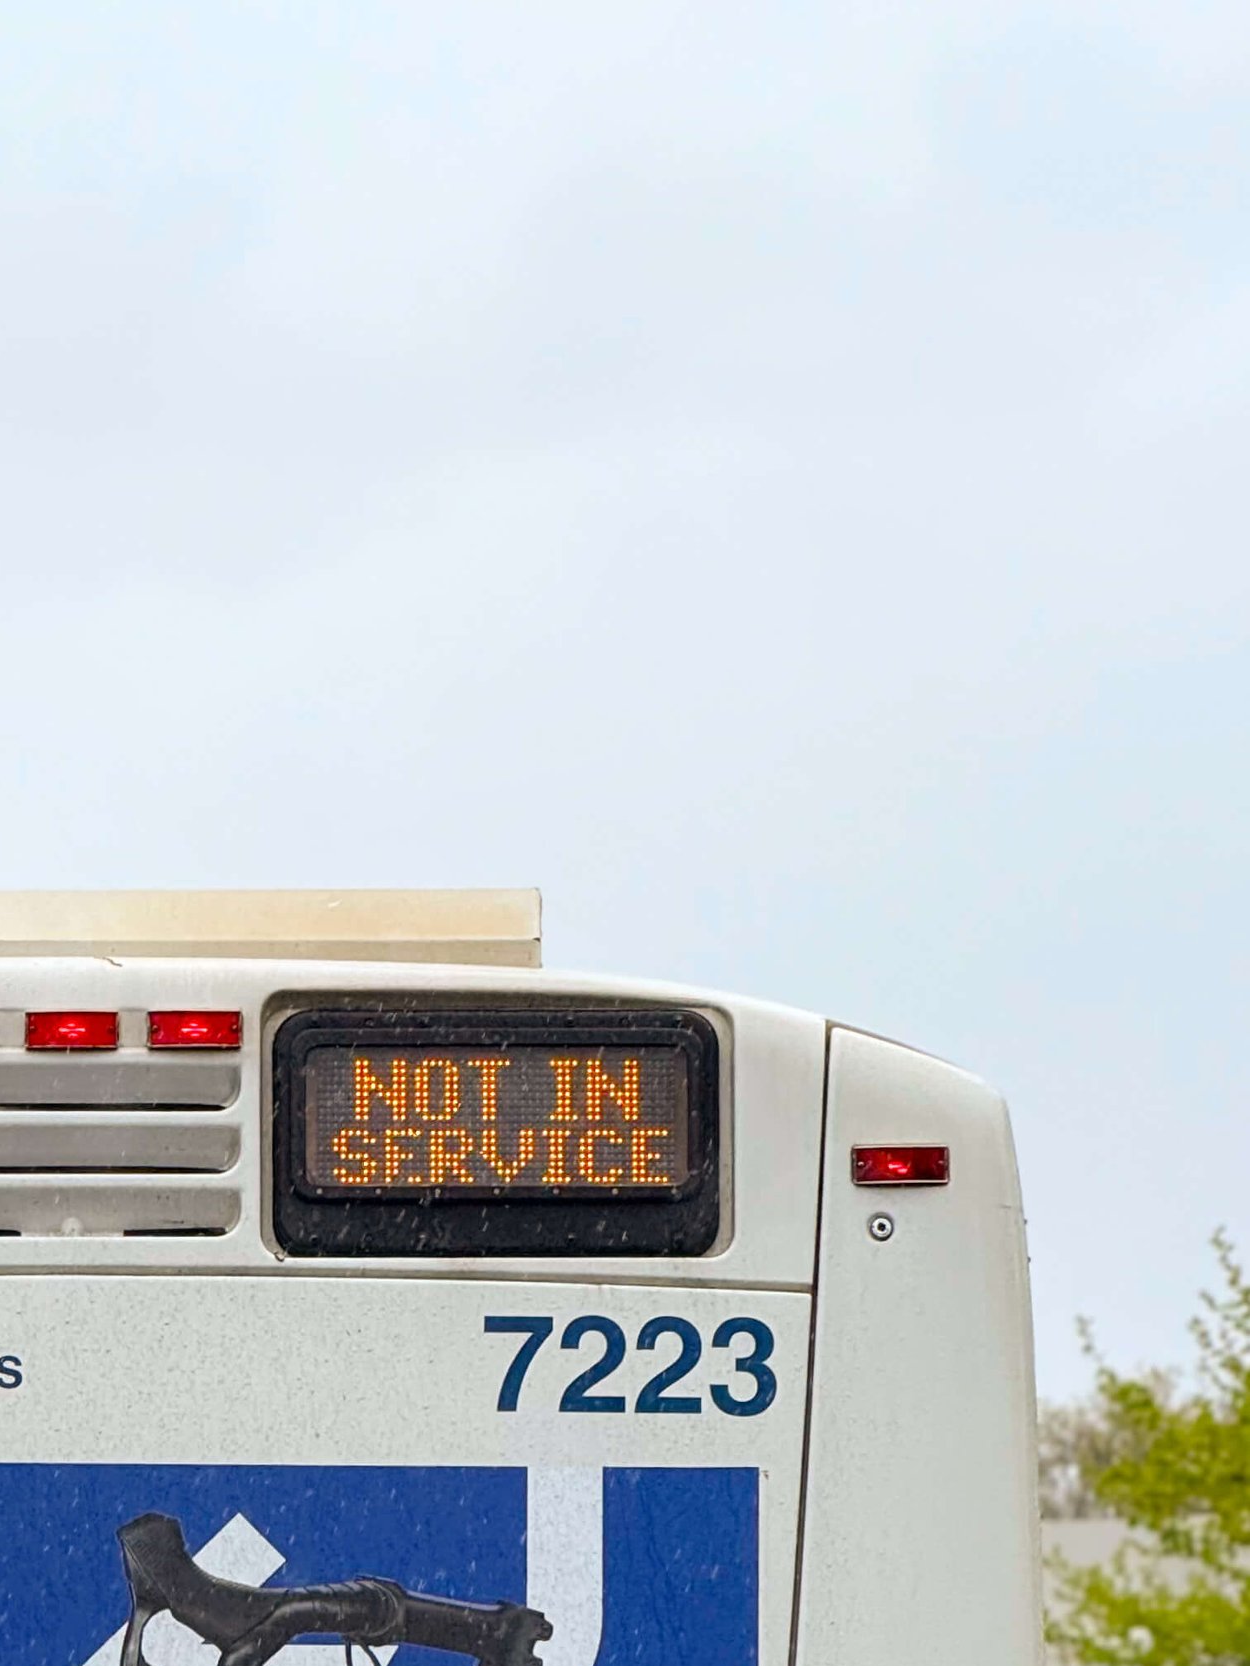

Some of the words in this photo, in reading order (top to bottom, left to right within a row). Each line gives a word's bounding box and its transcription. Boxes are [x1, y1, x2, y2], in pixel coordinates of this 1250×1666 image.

[354, 1058, 510, 1121] NOT
[549, 1058, 640, 1121] IN
[332, 1128, 669, 1184] SERVICE
[484, 1315, 777, 1417] 7223
